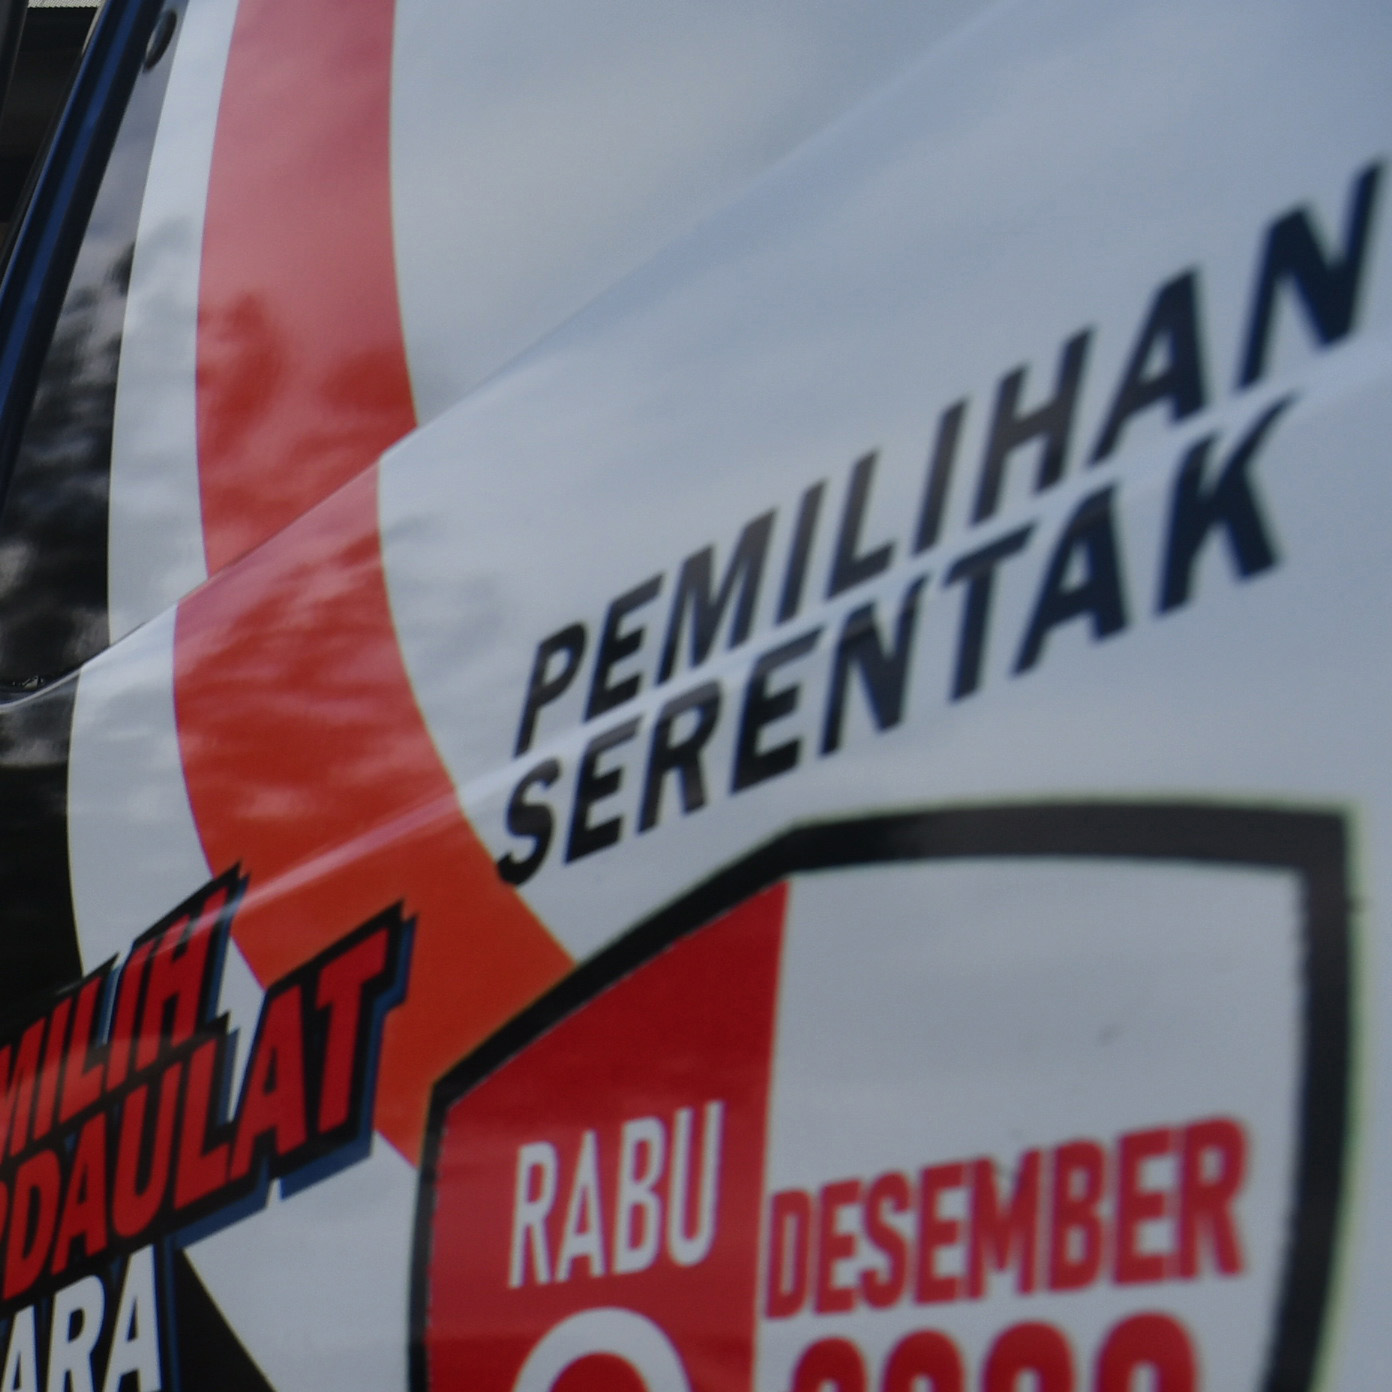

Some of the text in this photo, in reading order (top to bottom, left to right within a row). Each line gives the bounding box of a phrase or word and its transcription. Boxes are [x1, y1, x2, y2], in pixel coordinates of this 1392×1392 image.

[513, 155, 1386, 760] PEMILIHAN
[496, 388, 1302, 888] SERENTAK
[507, 1099, 726, 1289] RABU
[763, 1116, 1250, 1321] DESEMBER
